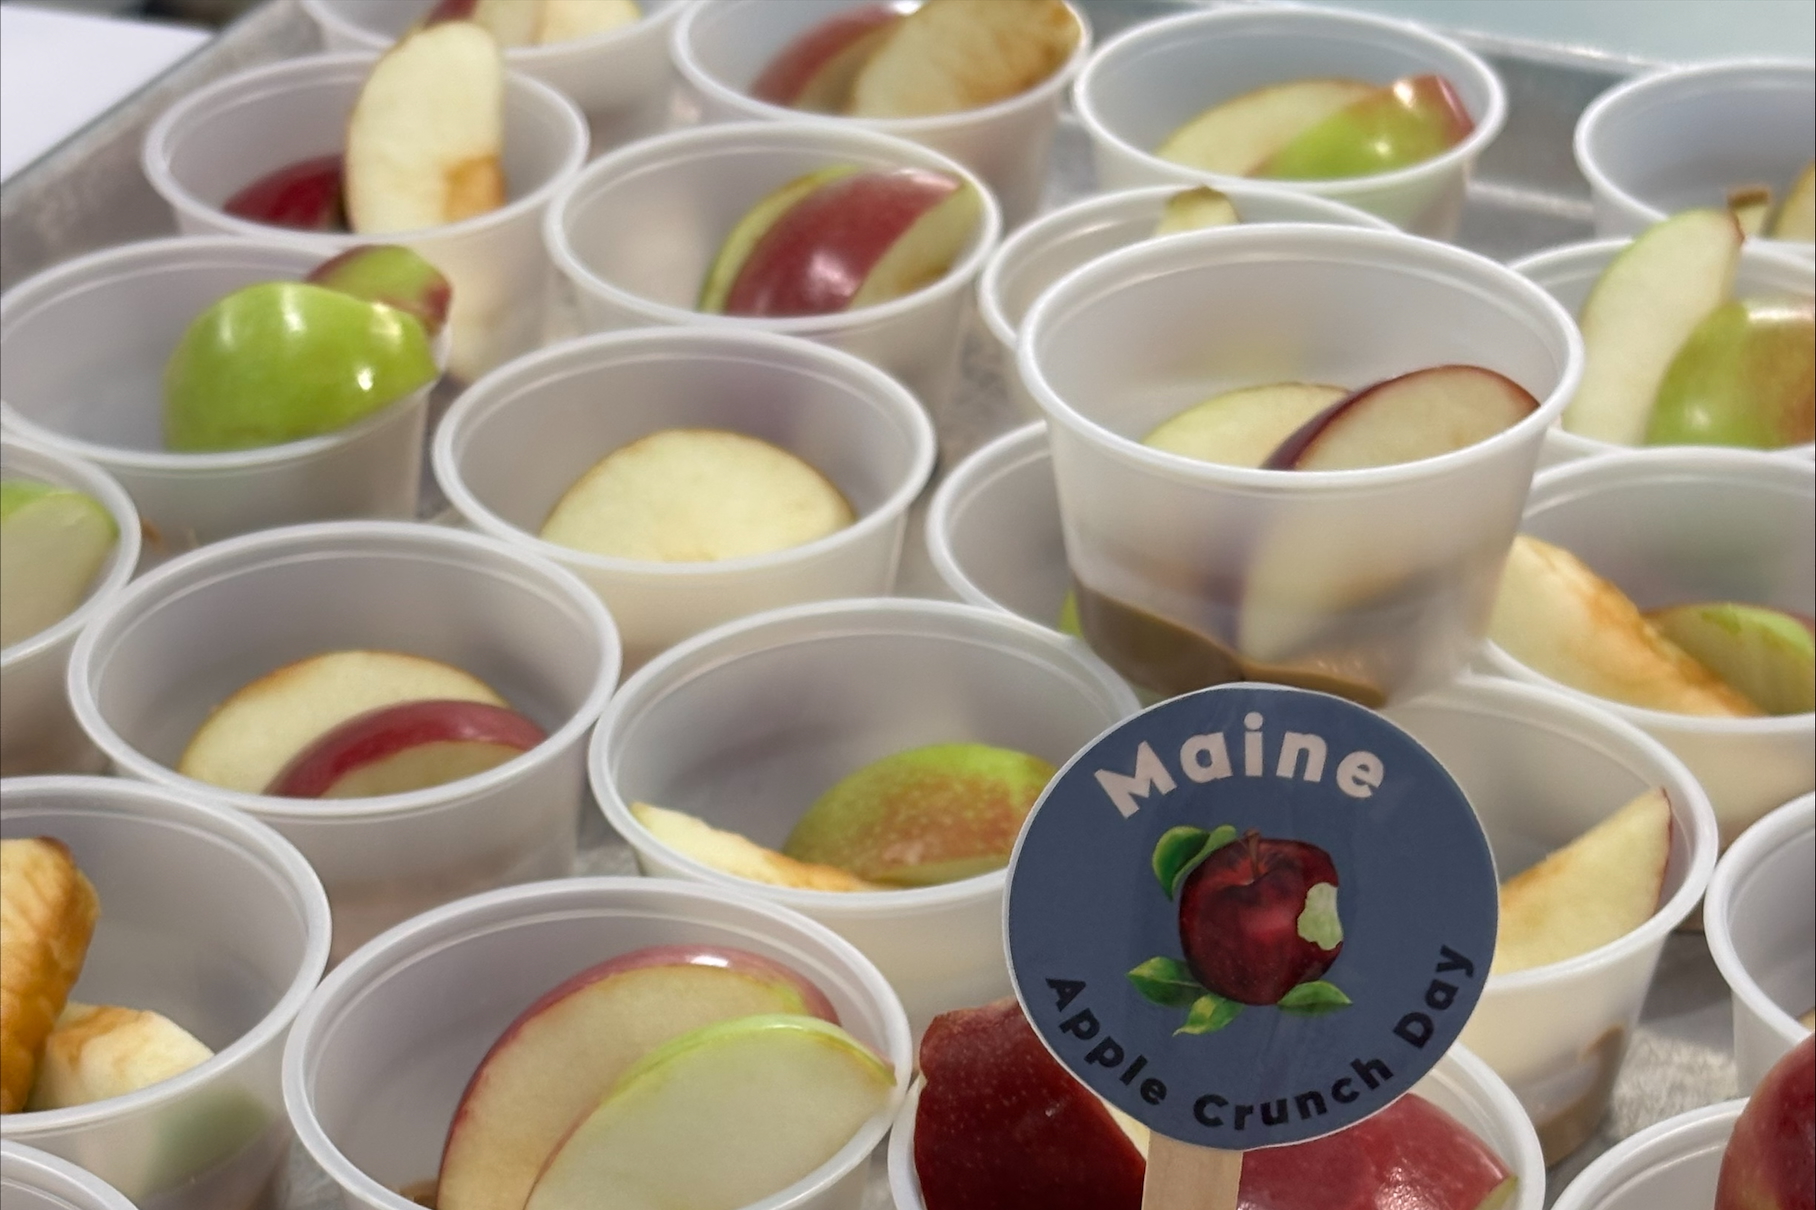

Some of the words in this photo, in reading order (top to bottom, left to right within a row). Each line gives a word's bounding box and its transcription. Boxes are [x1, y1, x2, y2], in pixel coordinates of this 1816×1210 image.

[1094, 711, 1386, 820] Maine
[1045, 977, 1168, 1106] Apple
[1193, 1058, 1394, 1131] Crunch
[1393, 944, 1474, 1049] Day
